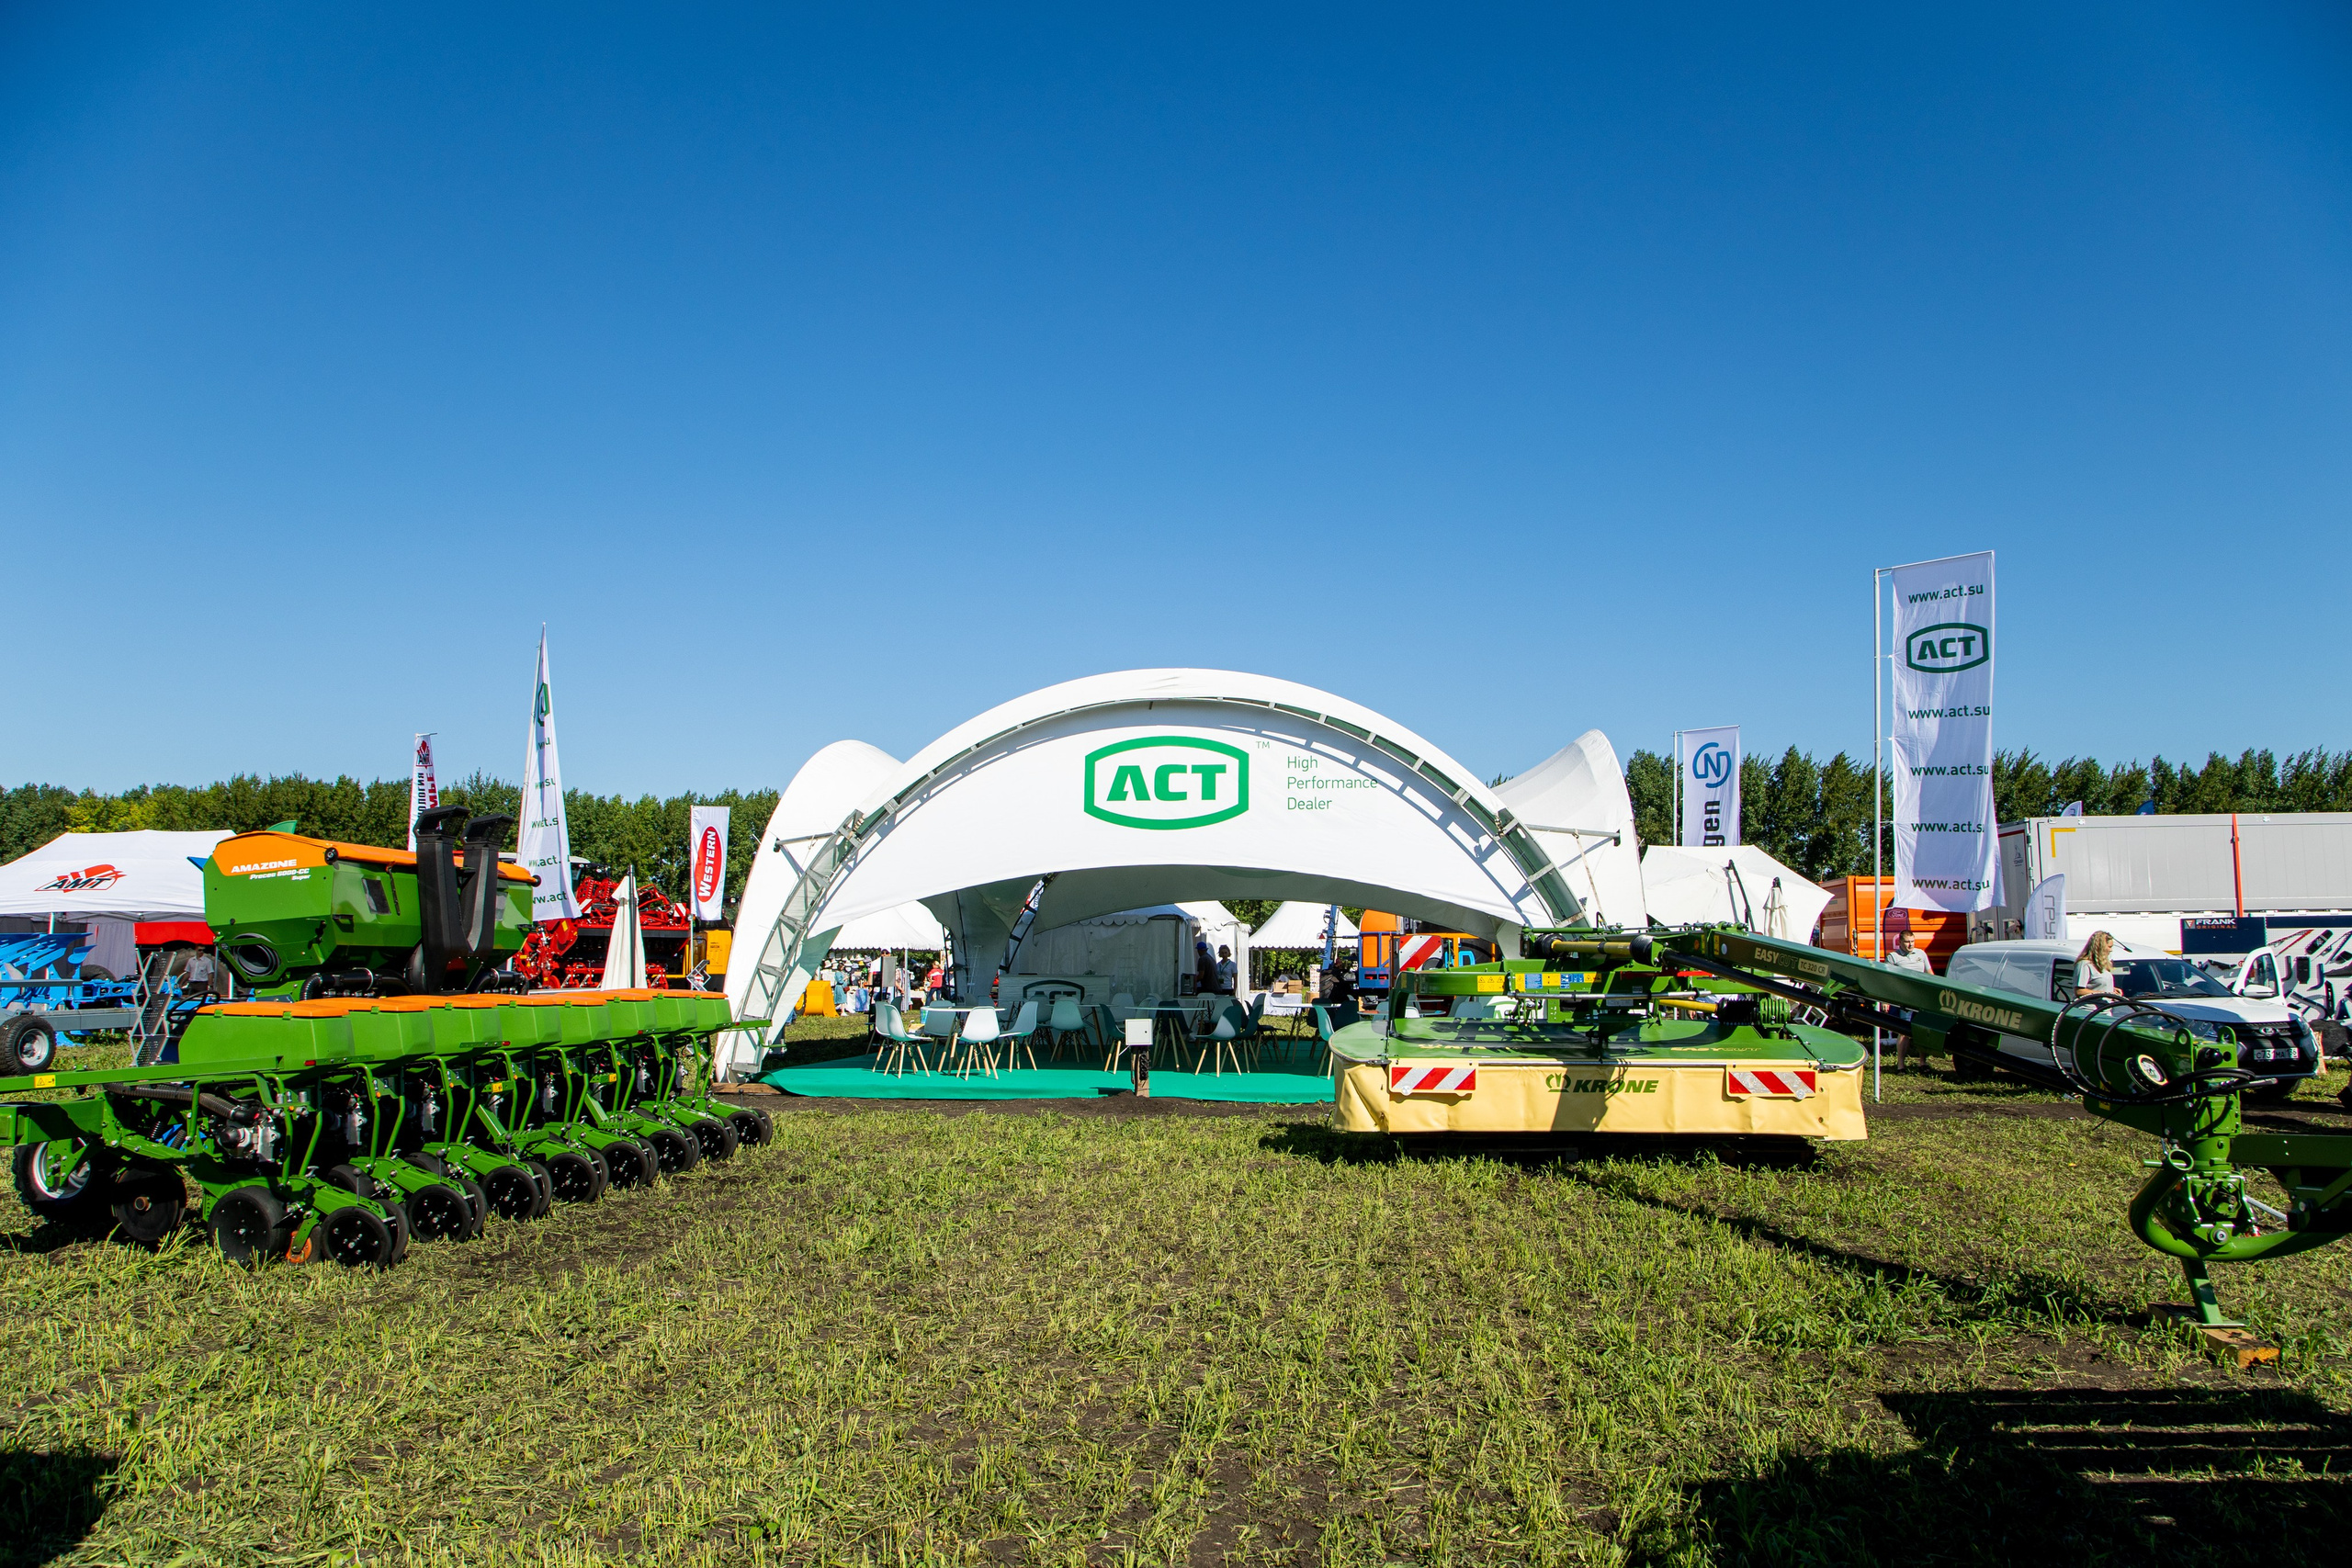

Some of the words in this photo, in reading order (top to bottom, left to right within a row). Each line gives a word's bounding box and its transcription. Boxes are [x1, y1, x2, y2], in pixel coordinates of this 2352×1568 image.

[1908, 584, 1984, 604] www.act.su
[1917, 636, 1976, 660] ACT
[1908, 705, 1990, 719] www.act.su
[1287, 755, 1317, 772] High
[1910, 763, 1989, 776] www.act.su
[1106, 764, 1227, 802] ACT
[1287, 776, 1378, 789] Performance
[1287, 796, 1332, 810] Dealer
[231, 859, 297, 873] AMAZONE
[698, 830, 717, 897] WESTERN
[1912, 879, 1990, 891] www.act.su
[1801, 961, 1807, 969] TC
[1808, 963, 1817, 972] 320
[1957, 999, 2022, 1029] KRONE
[1573, 1079, 1659, 1093] KRONE
